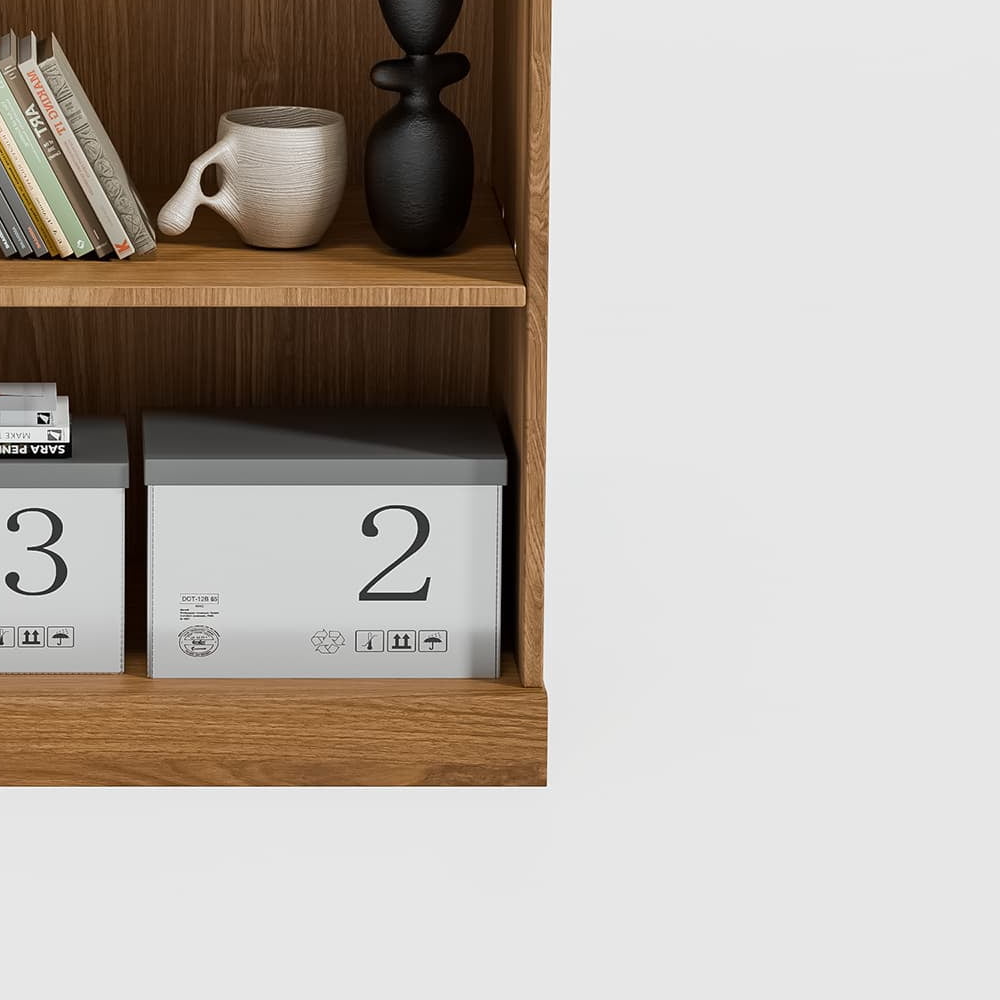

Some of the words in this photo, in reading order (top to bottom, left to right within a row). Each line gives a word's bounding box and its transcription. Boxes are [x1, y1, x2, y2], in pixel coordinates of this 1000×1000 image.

[6, 432, 31, 440] MAKE
[30, 444, 66, 454] SARA
[5, 508, 68, 596] 3
[359, 505, 431, 601] 2
